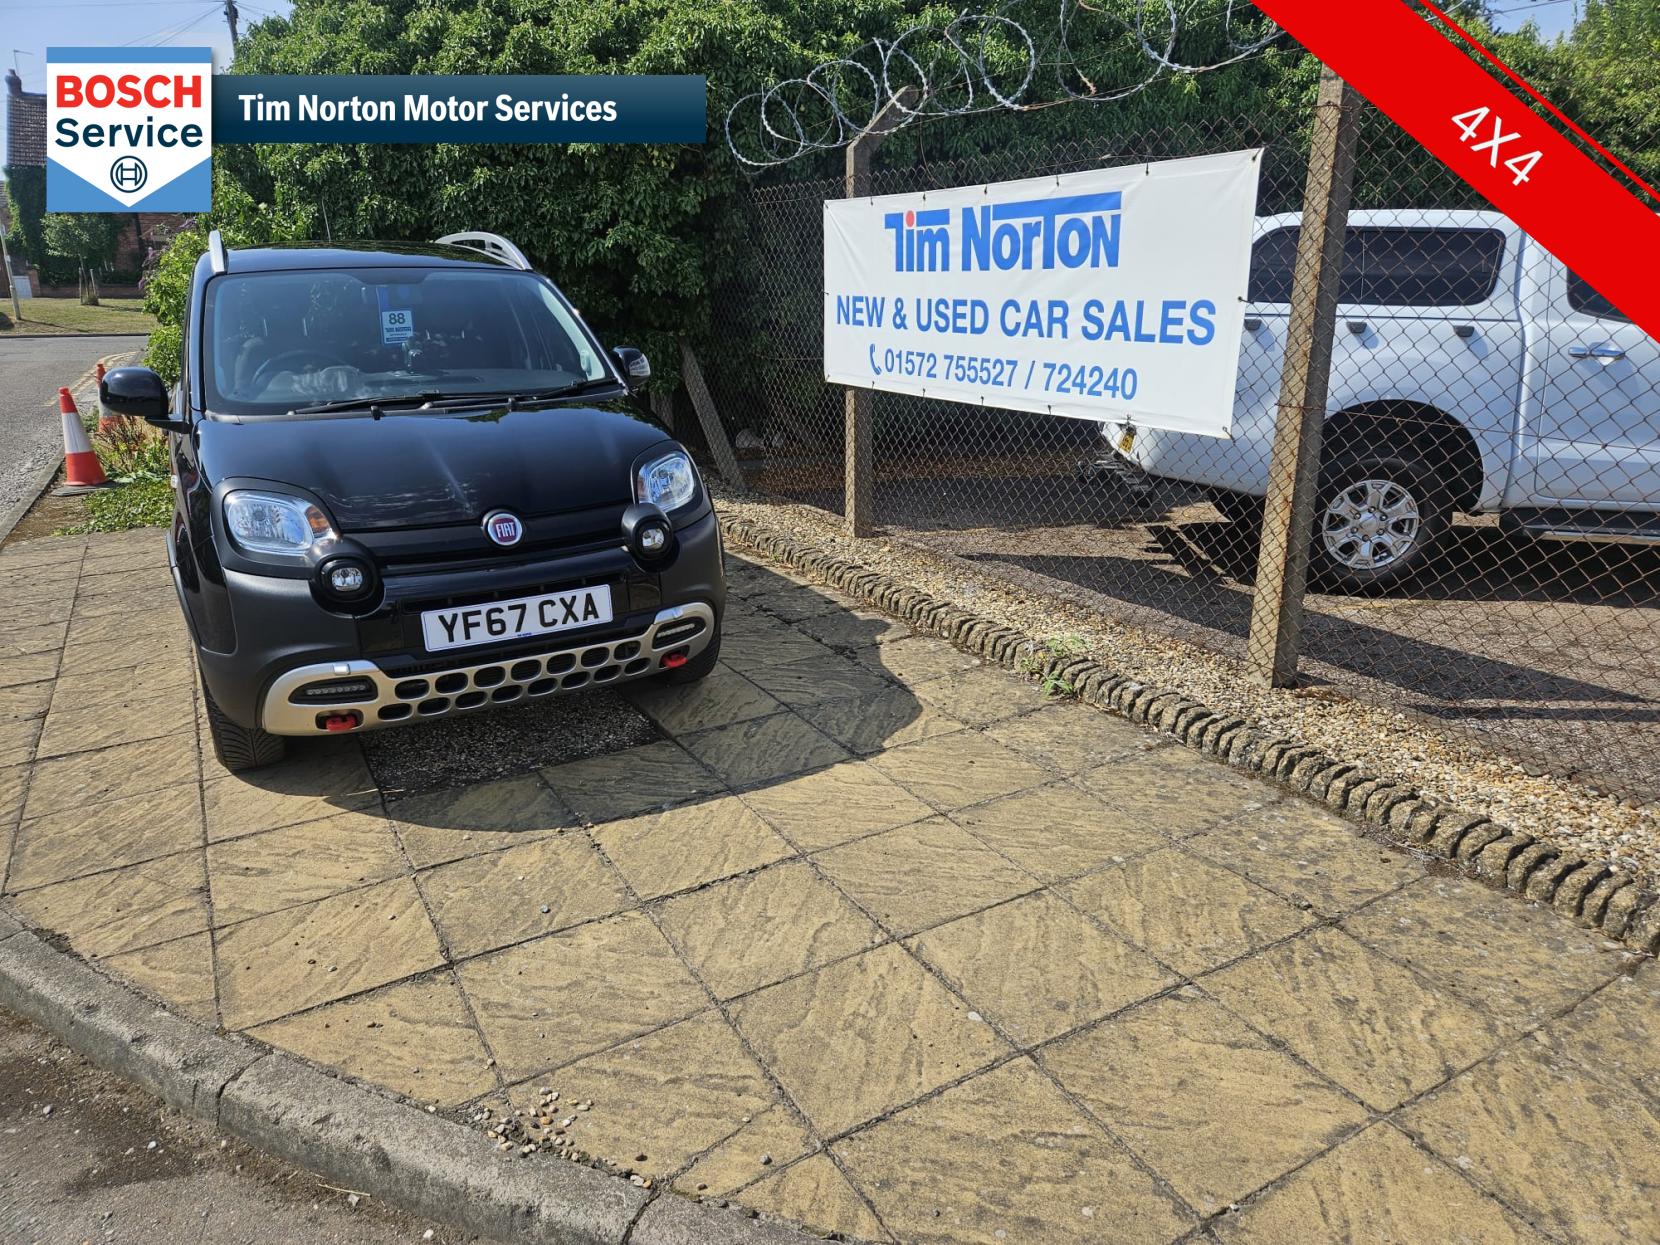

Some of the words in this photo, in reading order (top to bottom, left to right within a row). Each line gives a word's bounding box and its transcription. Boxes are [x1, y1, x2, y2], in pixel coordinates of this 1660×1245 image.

[884, 208, 951, 272] Tim
[389, 313, 406, 324] 88
[837, 294, 886, 328] NEW
[892, 297, 908, 331] &
[916, 299, 989, 335] USED
[1000, 300, 1069, 339] CAR
[1082, 299, 1217, 346] SALES
[884, 348, 937, 379] 01572
[944, 353, 1018, 387] 755527
[1024, 360, 1034, 389] /
[1043, 362, 1138, 400] 724240
[495, 522, 516, 538] FIAT
[438, 603, 527, 643] YF67
[538, 592, 600, 628] CXA
